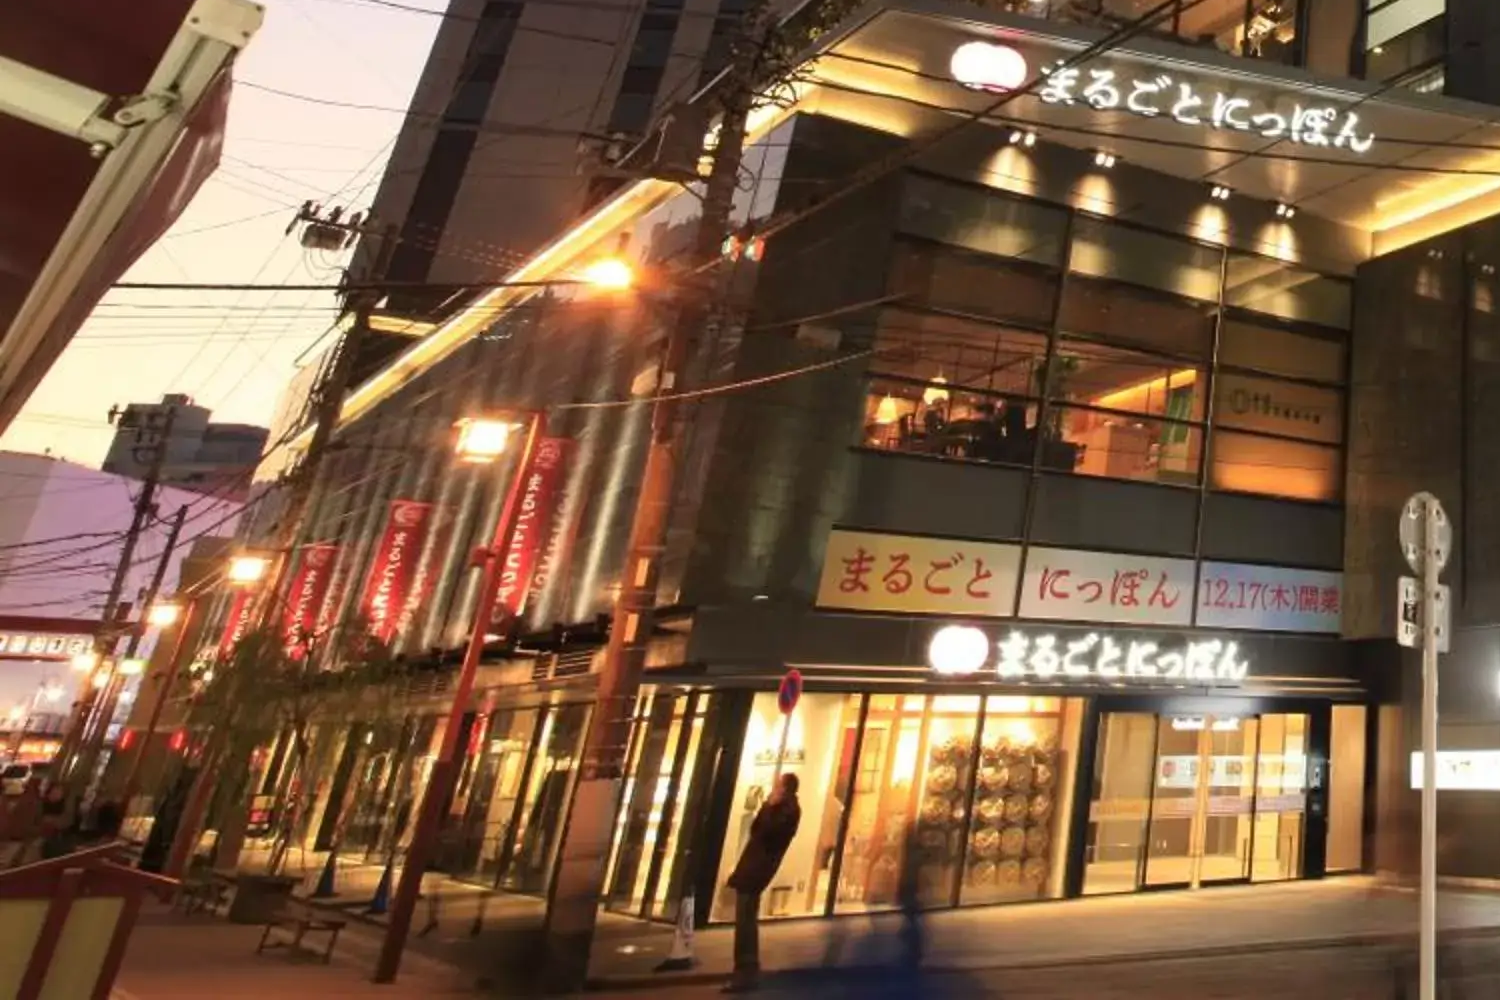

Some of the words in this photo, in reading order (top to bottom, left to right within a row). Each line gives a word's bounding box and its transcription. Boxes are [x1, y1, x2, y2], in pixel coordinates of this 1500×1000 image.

[1039, 59, 1375, 154] まるごとにっぽん
[838, 547, 994, 600] まるごと
[1037, 566, 1180, 609] にっぽん
[997, 628, 1249, 681] まるごとにっぽん
